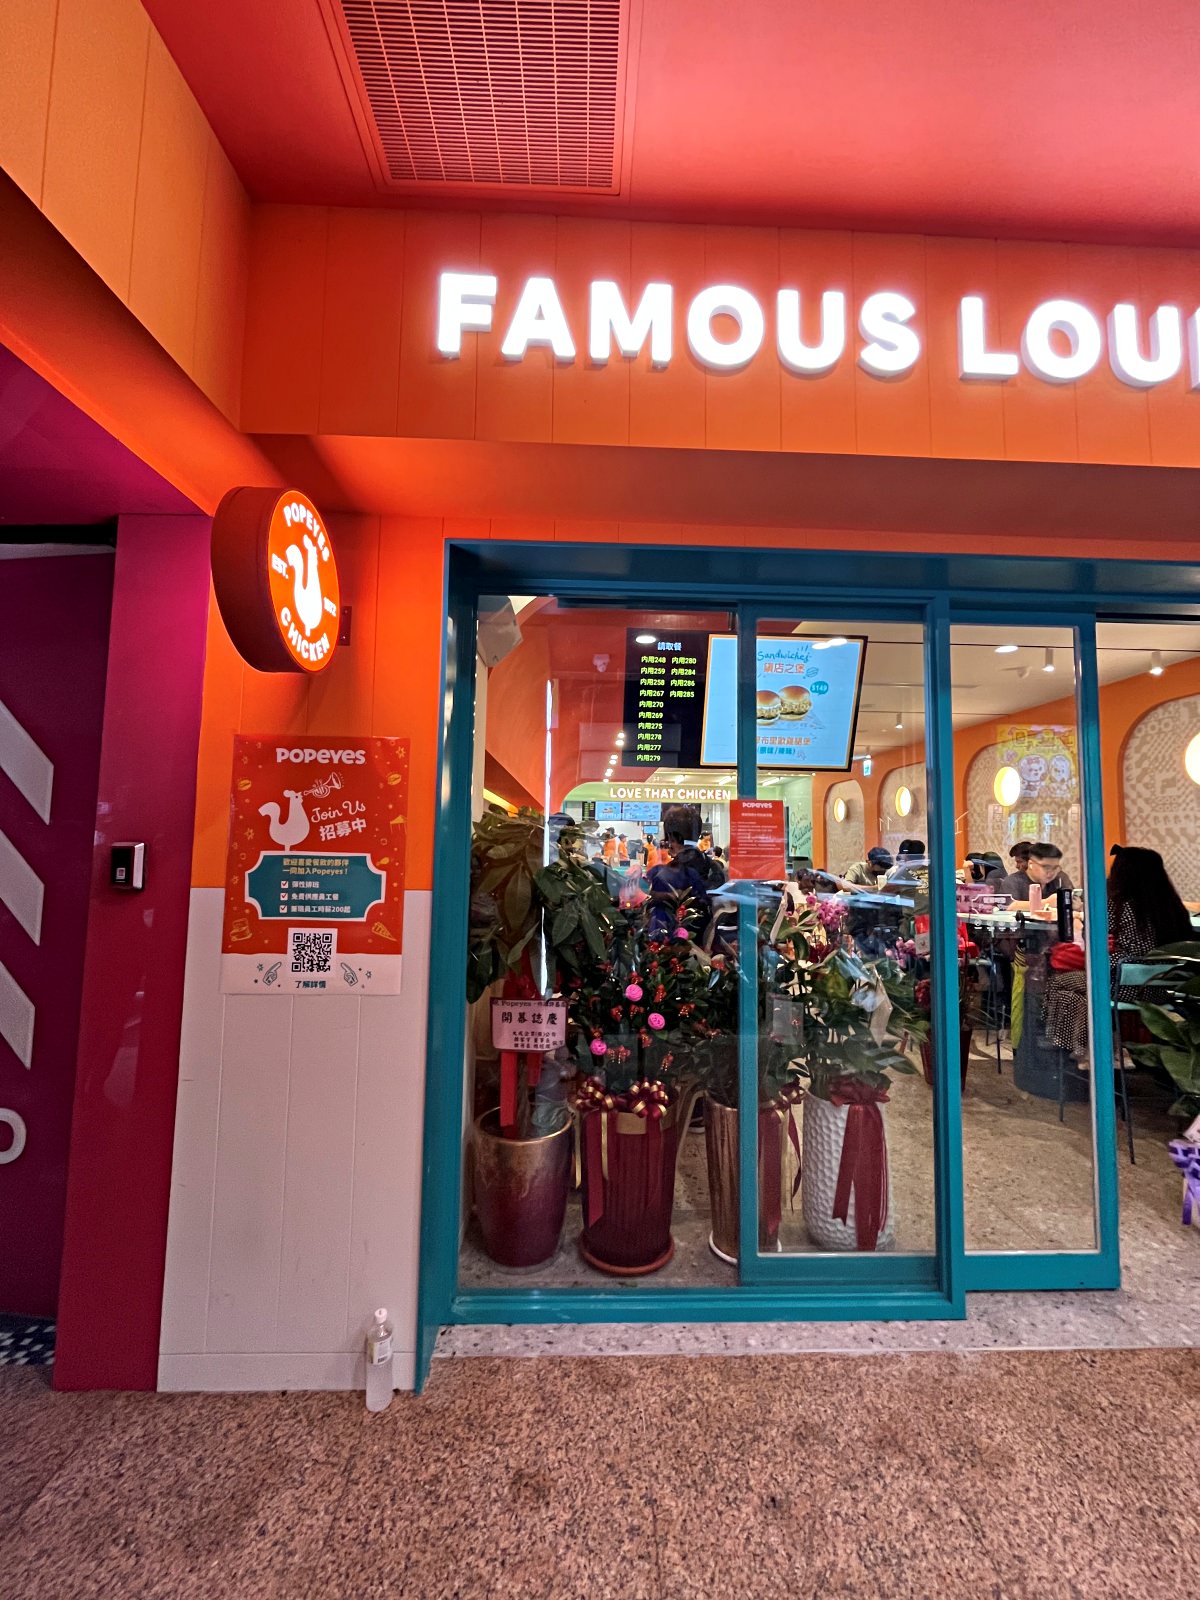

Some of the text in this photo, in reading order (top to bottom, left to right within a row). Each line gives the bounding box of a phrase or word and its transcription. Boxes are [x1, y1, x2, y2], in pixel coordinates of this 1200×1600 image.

[437, 272, 922, 378] FAMOUS
[283, 502, 330, 562] POPEYES
[280, 606, 330, 662] CHICKEN
[757, 649, 810, 663] Sandwiches
[609, 787, 731, 801] LOVE THAT CHICKEN
[311, 800, 367, 823] Join Us
[319, 817, 367, 841] 招募中
[294, 979, 327, 989] 了解詳情
[501, 1012, 558, 1025] 開幕誌慶
